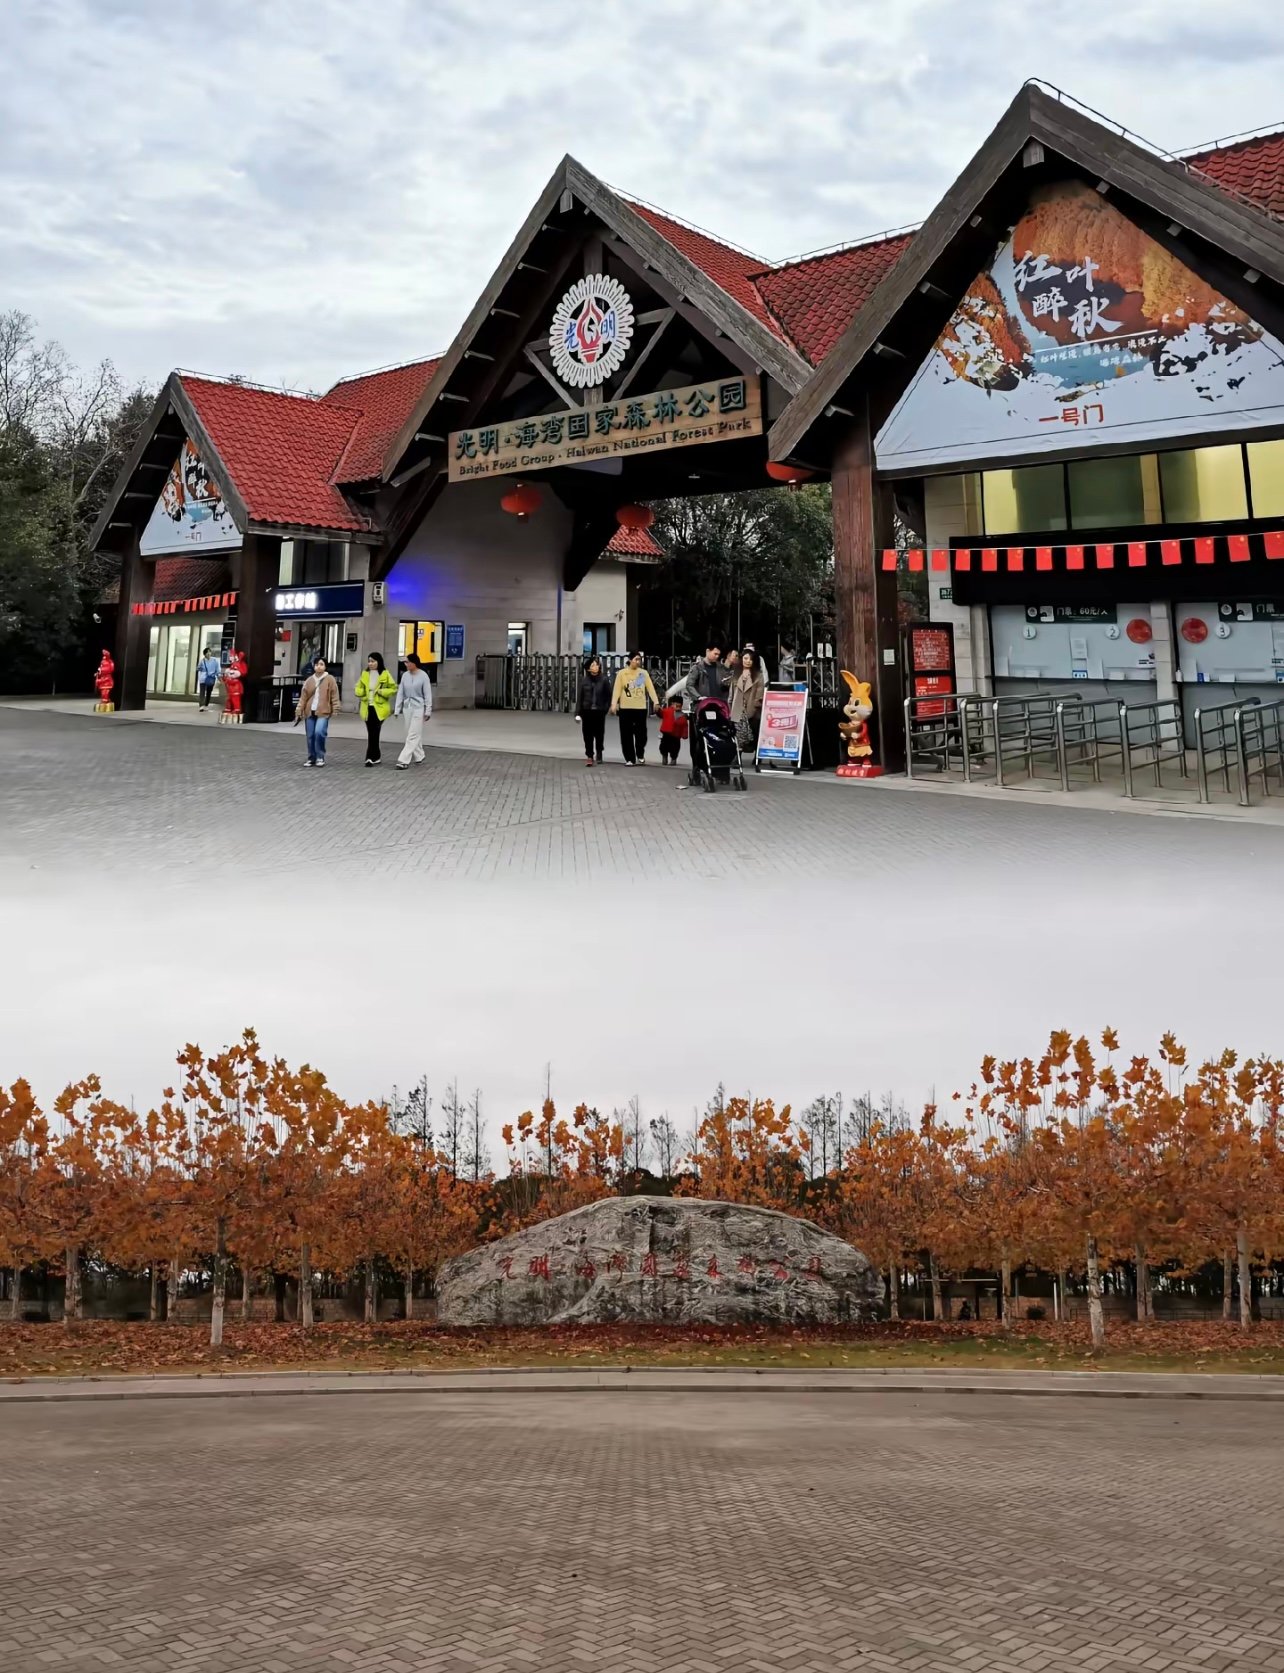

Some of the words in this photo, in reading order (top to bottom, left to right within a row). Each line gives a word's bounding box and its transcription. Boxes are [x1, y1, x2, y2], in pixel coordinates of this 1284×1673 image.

[1013, 250, 1099, 292] 红叶
[1032, 287, 1123, 338] 醉秋
[1039, 404, 1104, 426] 一号门
[459, 464, 489, 476] Bright
[493, 457, 517, 471] Food
[521, 453, 555, 467] Group
[613, 432, 667, 450] National
[672, 426, 714, 442] Forest
[718, 417, 752, 434] Park
